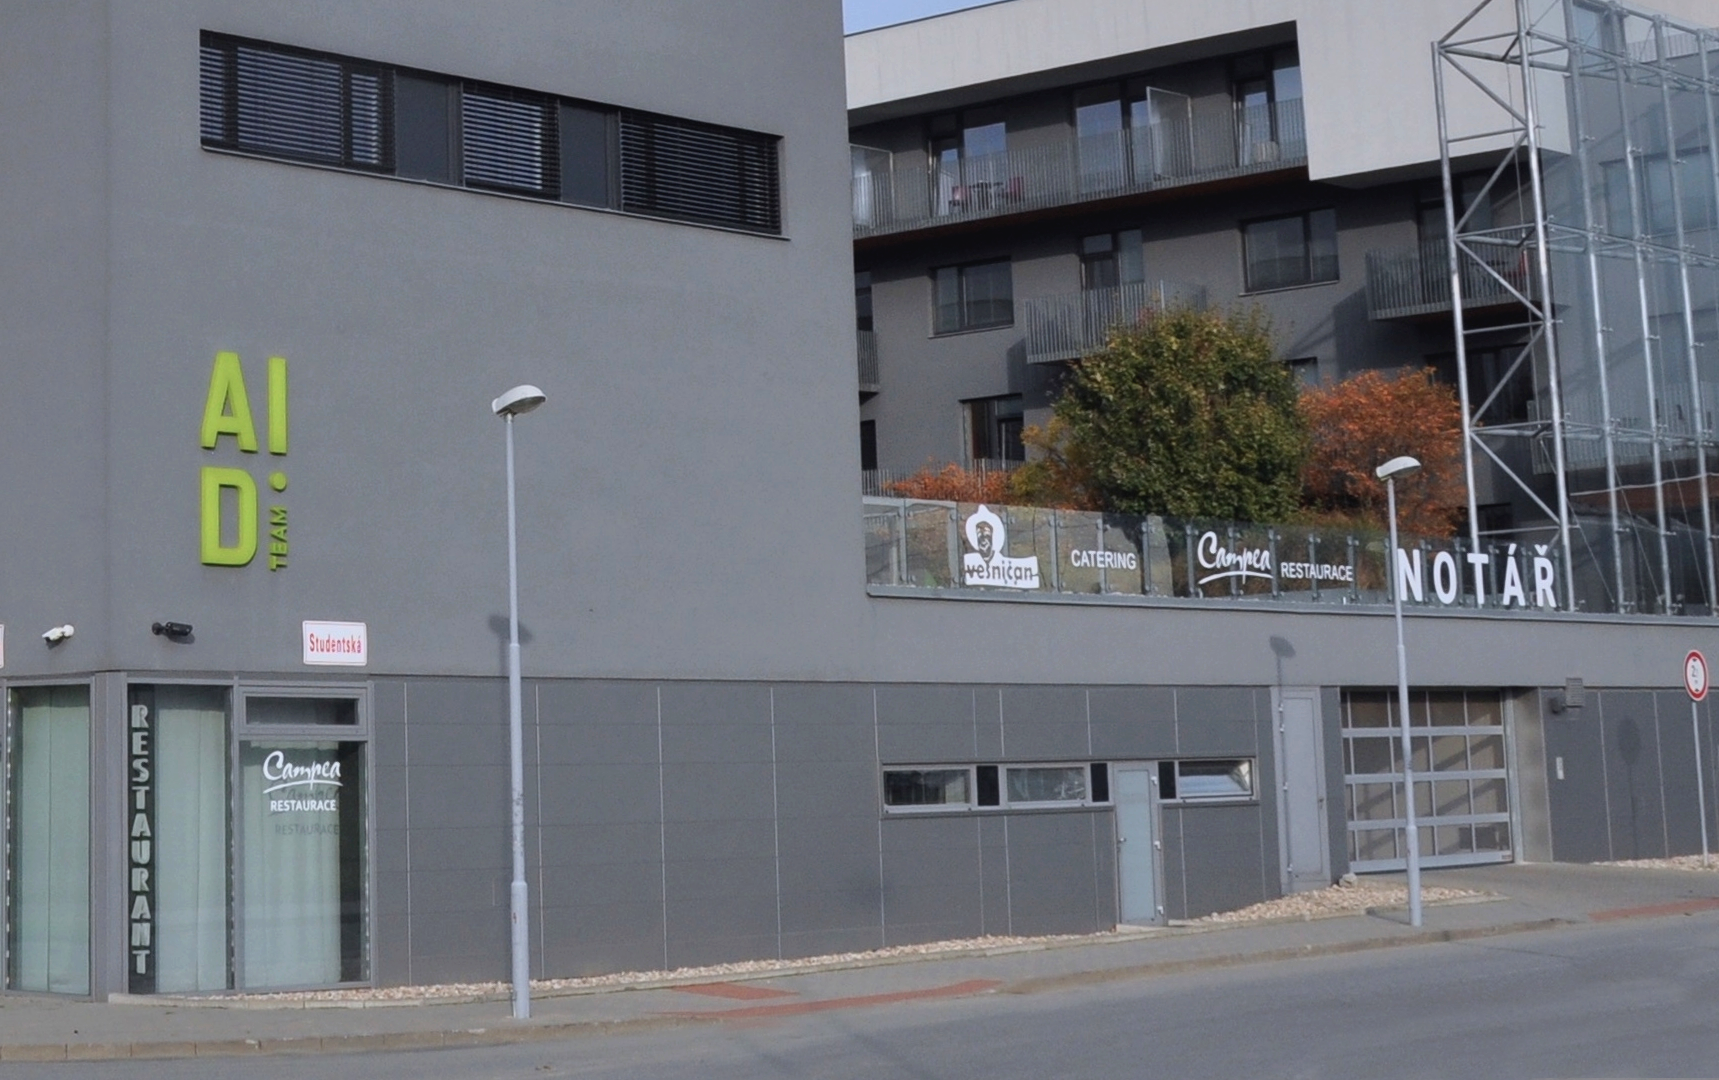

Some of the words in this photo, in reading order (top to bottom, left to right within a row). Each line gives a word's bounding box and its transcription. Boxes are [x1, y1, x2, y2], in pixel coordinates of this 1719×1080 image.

[269, 506, 287, 572] TEAM
[1071, 549, 1137, 570] CATERING
[1197, 530, 1274, 585] Campea
[1280, 561, 1354, 582] RESTAURACE
[1396, 542, 1557, 609] NOTÁŘ
[309, 633, 362, 653] Studentská
[263, 750, 343, 791] Campea
[270, 799, 337, 812] RESTAURACE
[130, 704, 152, 975] RESTAURANT
